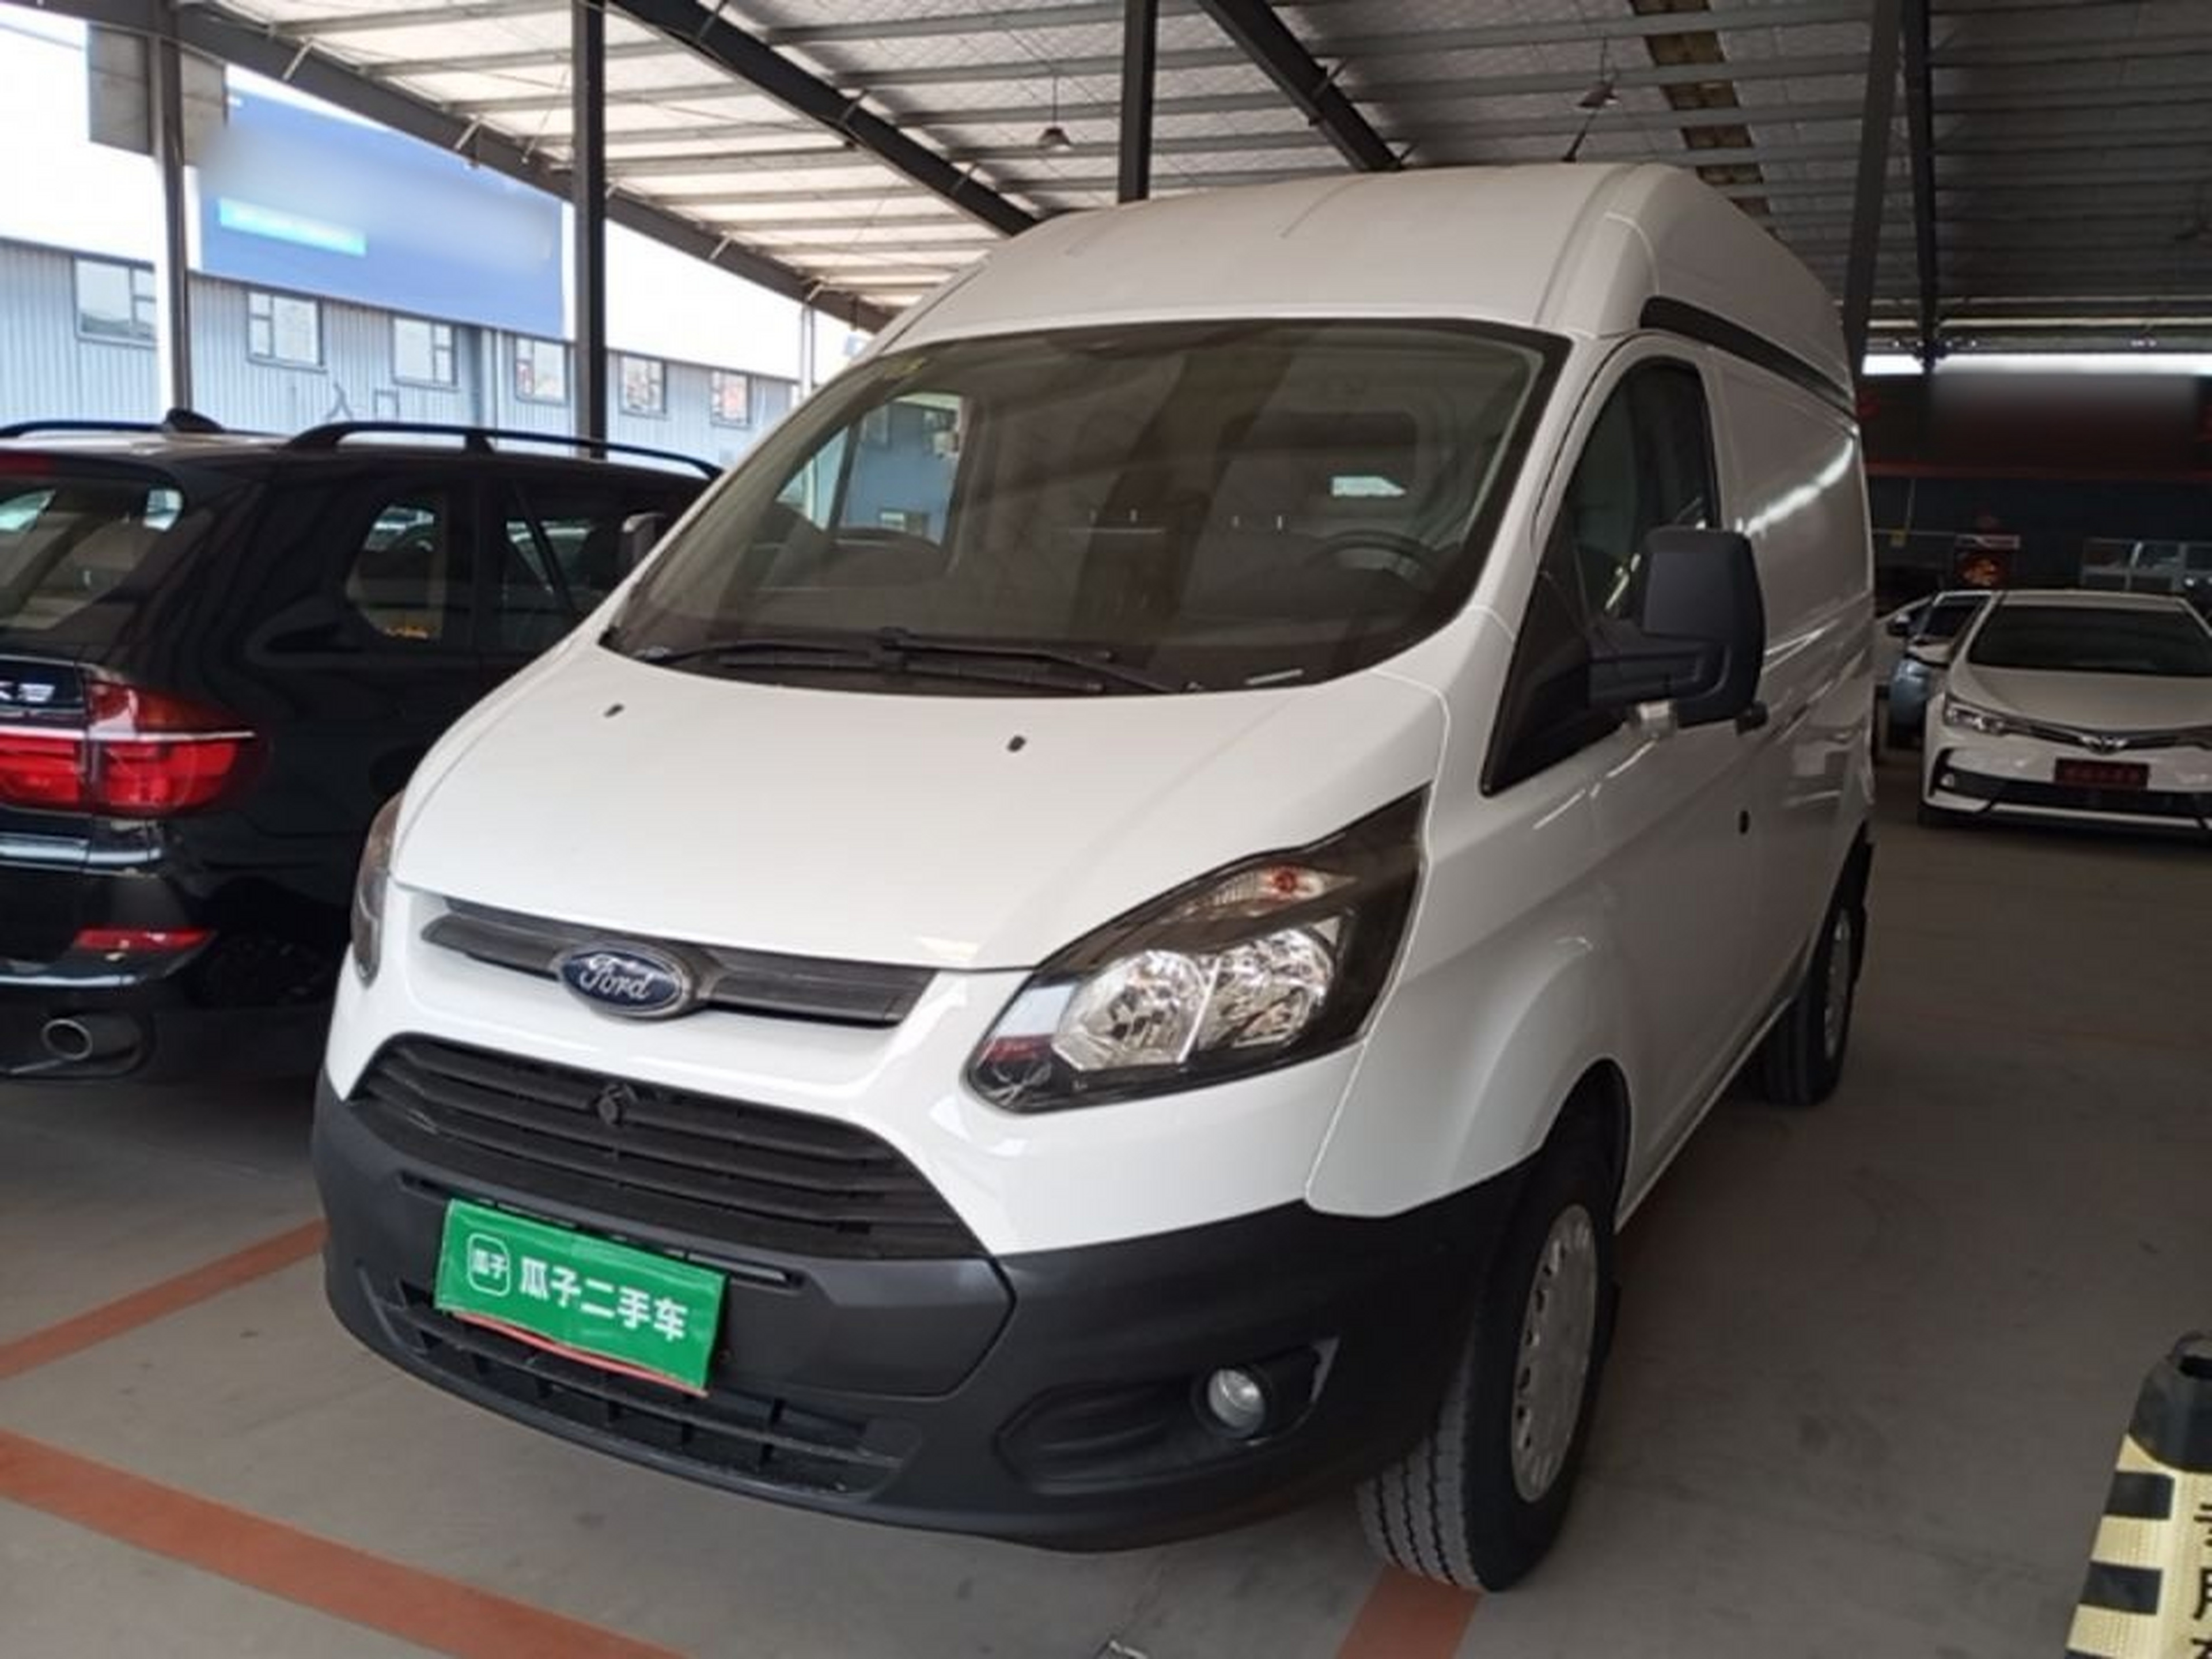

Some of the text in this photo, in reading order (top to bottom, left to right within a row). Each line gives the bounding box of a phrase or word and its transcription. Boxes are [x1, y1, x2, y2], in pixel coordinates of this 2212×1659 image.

[579, 954, 652, 1000] Ford
[520, 1256, 689, 1342] 瓜子二手车
